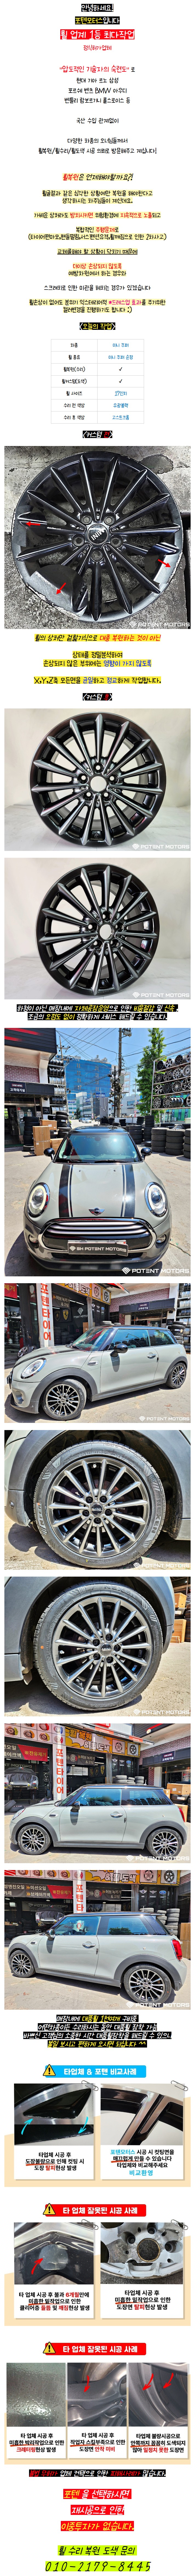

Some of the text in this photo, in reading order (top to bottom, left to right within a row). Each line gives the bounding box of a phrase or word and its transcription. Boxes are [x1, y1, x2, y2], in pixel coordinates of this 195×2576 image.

[41, 1283, 51, 1340] 포텐타이어
[70, 1729, 92, 1741] 휠 복원
[121, 1874, 136, 1883] 도색
